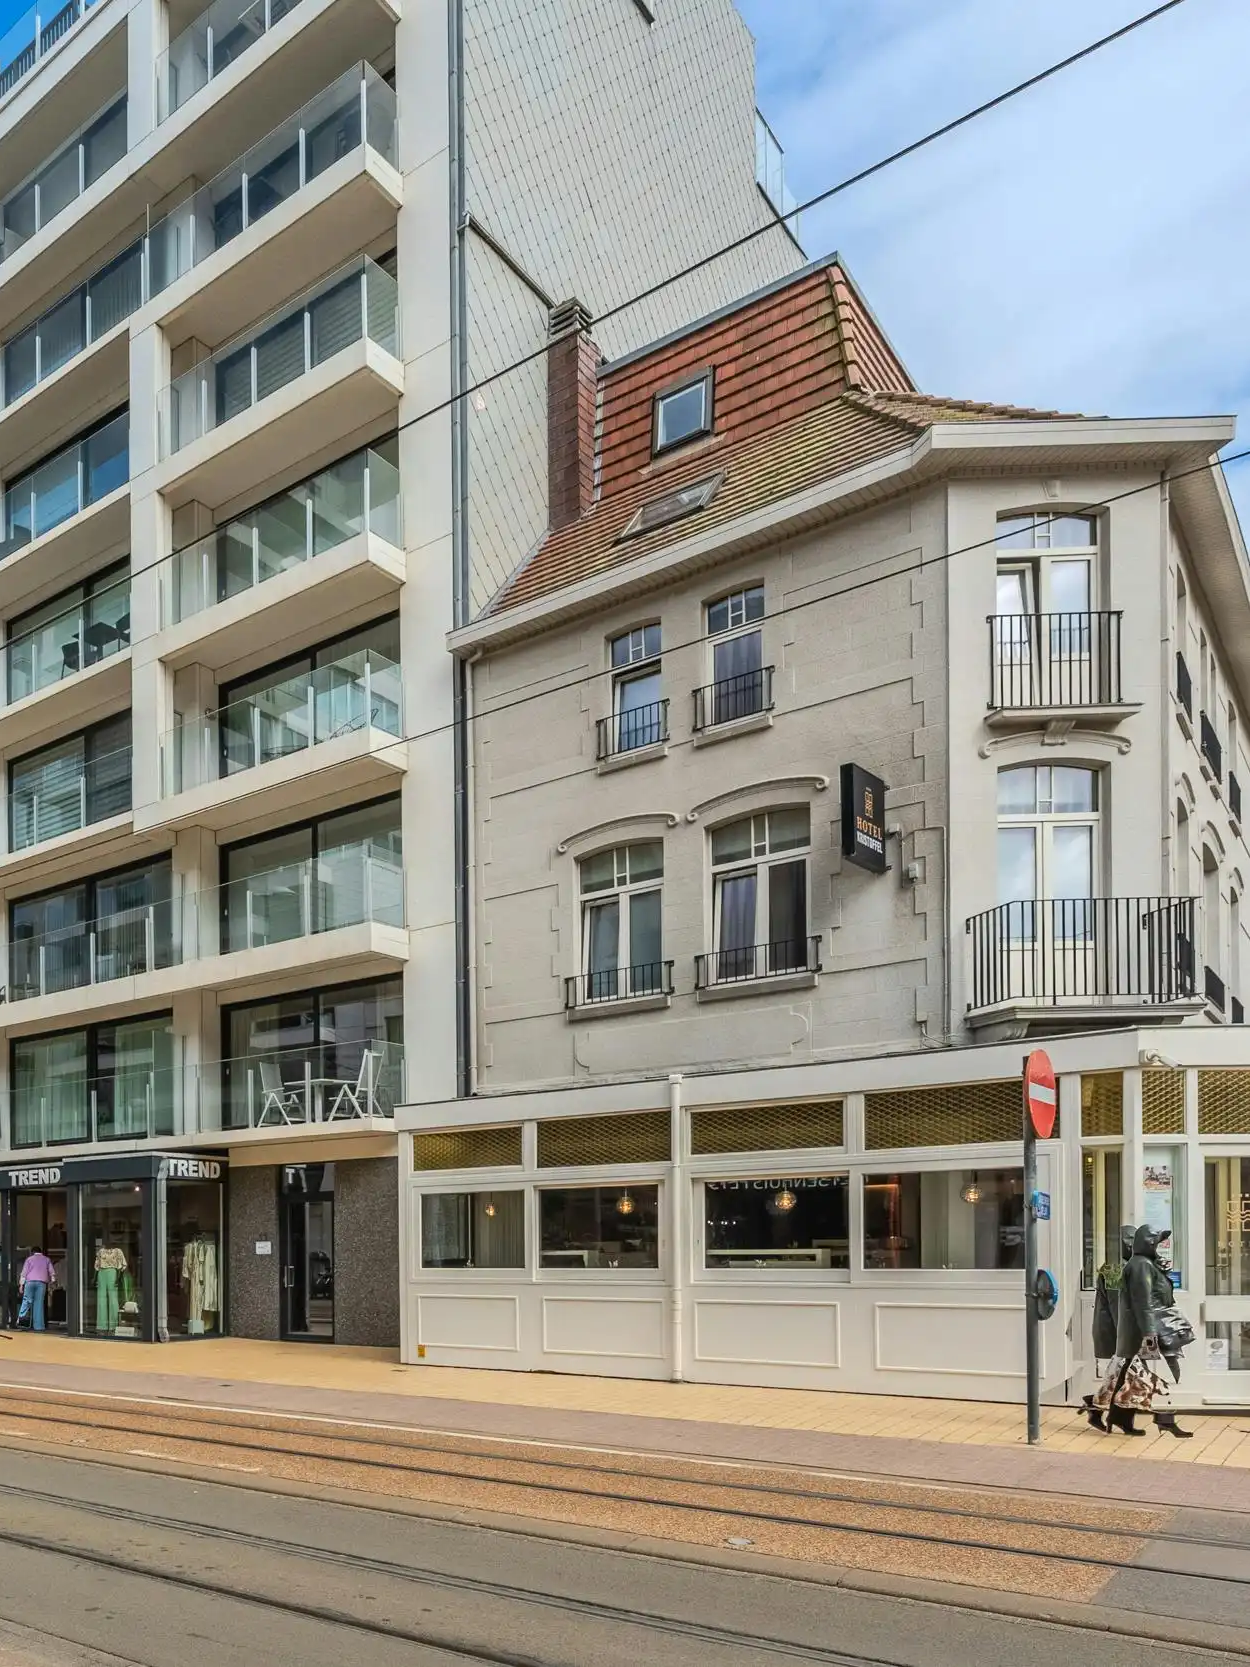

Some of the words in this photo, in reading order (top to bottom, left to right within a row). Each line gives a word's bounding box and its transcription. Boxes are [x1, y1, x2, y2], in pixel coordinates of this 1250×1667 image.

[856, 816, 882, 840] HOTEL
[856, 830, 883, 853] KRISTOFFEL
[8, 1167, 61, 1187] TREND
[168, 1158, 221, 1179] TREND
